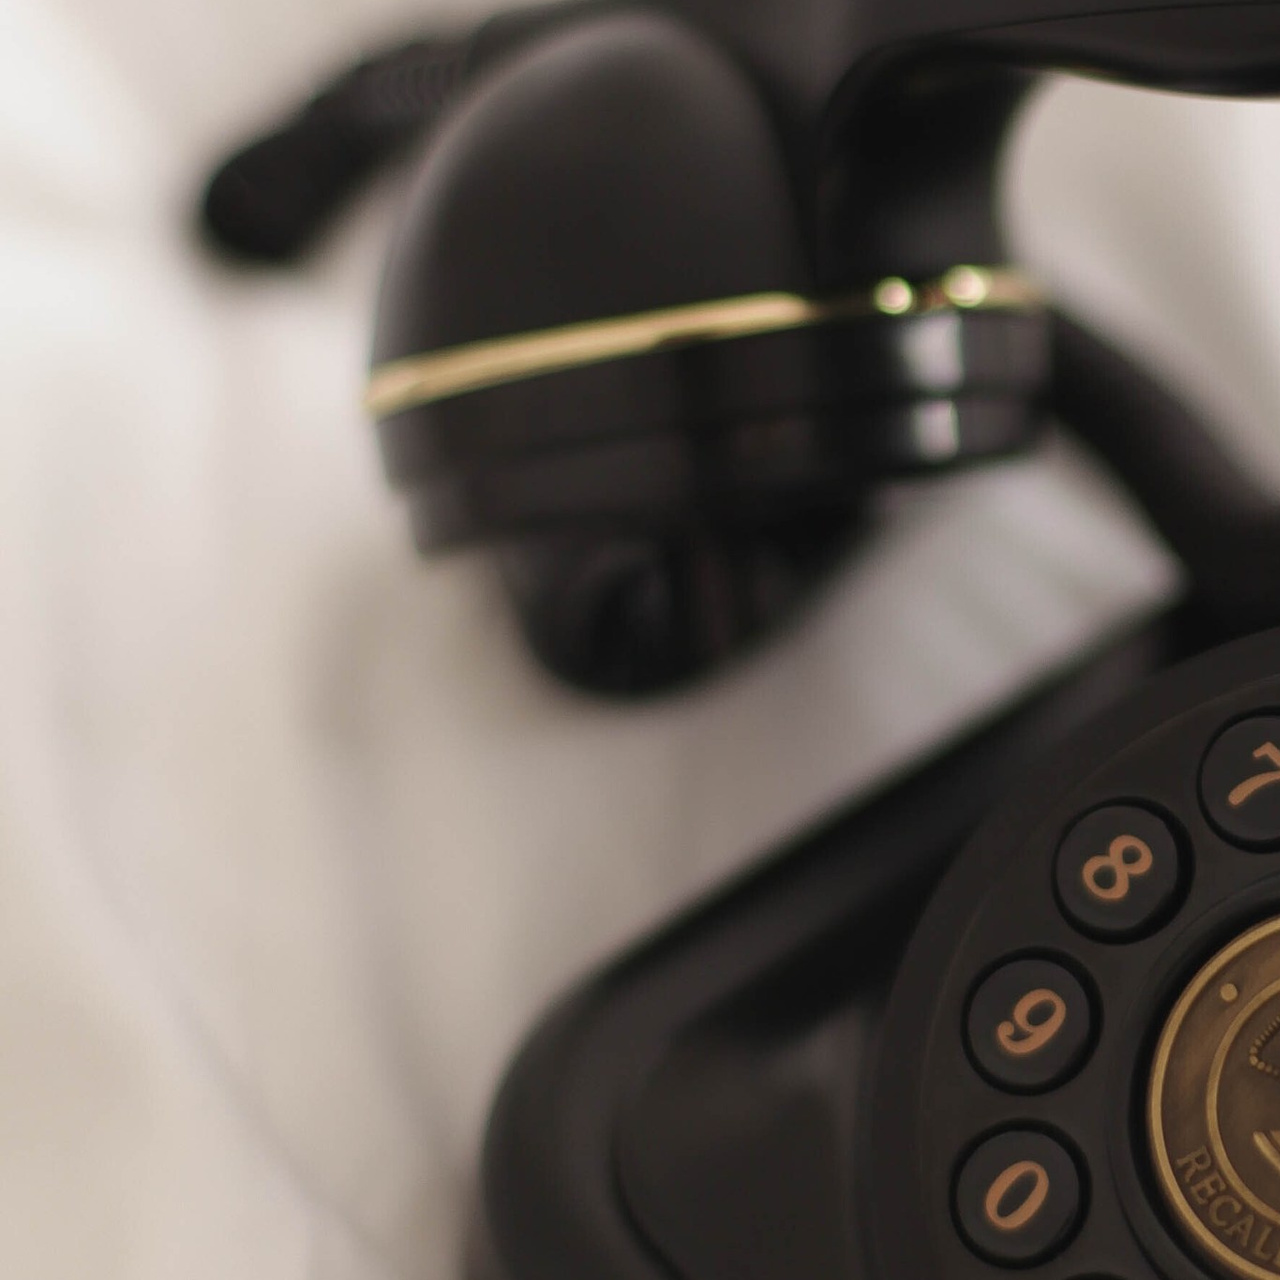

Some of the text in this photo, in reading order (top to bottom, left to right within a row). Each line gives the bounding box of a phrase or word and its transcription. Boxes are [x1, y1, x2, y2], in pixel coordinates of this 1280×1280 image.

[1081, 833, 1154, 902] 8
[996, 987, 1067, 1057] 9
[983, 1160, 1050, 1231] 0
